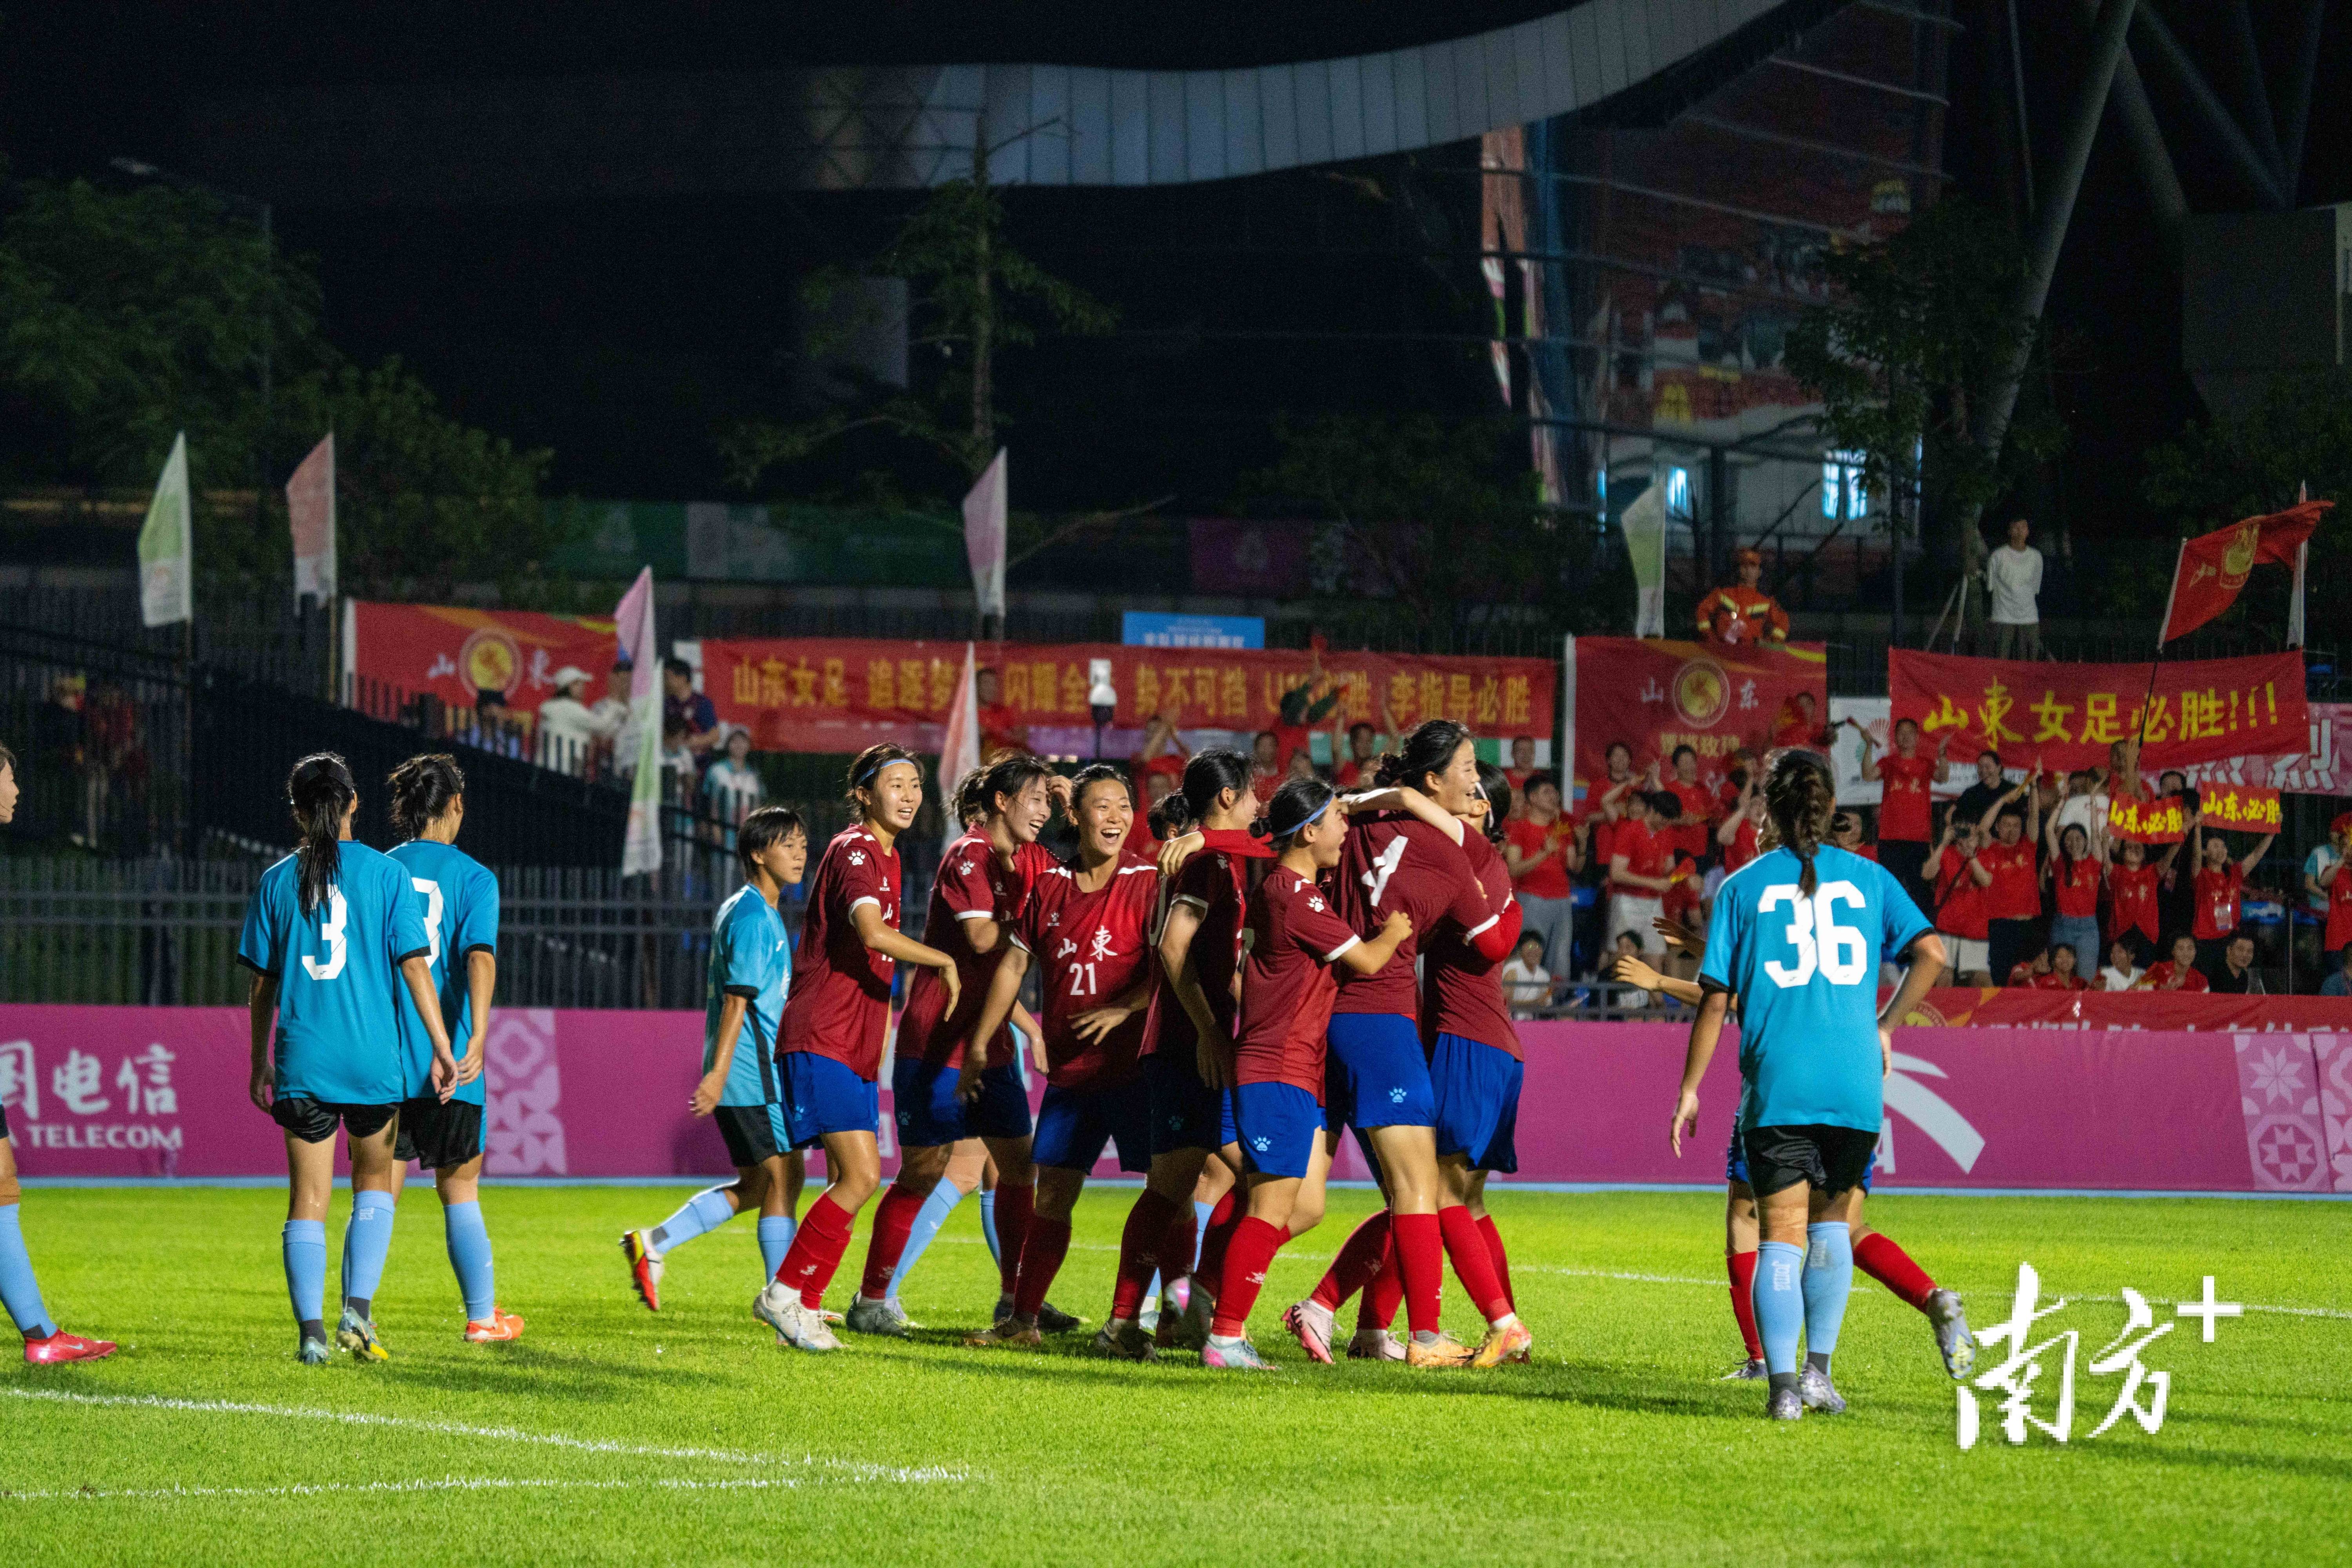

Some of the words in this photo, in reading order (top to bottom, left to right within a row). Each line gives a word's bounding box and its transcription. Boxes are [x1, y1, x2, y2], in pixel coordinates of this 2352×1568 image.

[733, 655, 848, 708] 山东女足
[867, 658, 984, 711] 追逐梦
[1758, 880, 1867, 988] 36
[1069, 962, 1096, 996] 21
[25, 1123, 183, 1149] TELECOM
